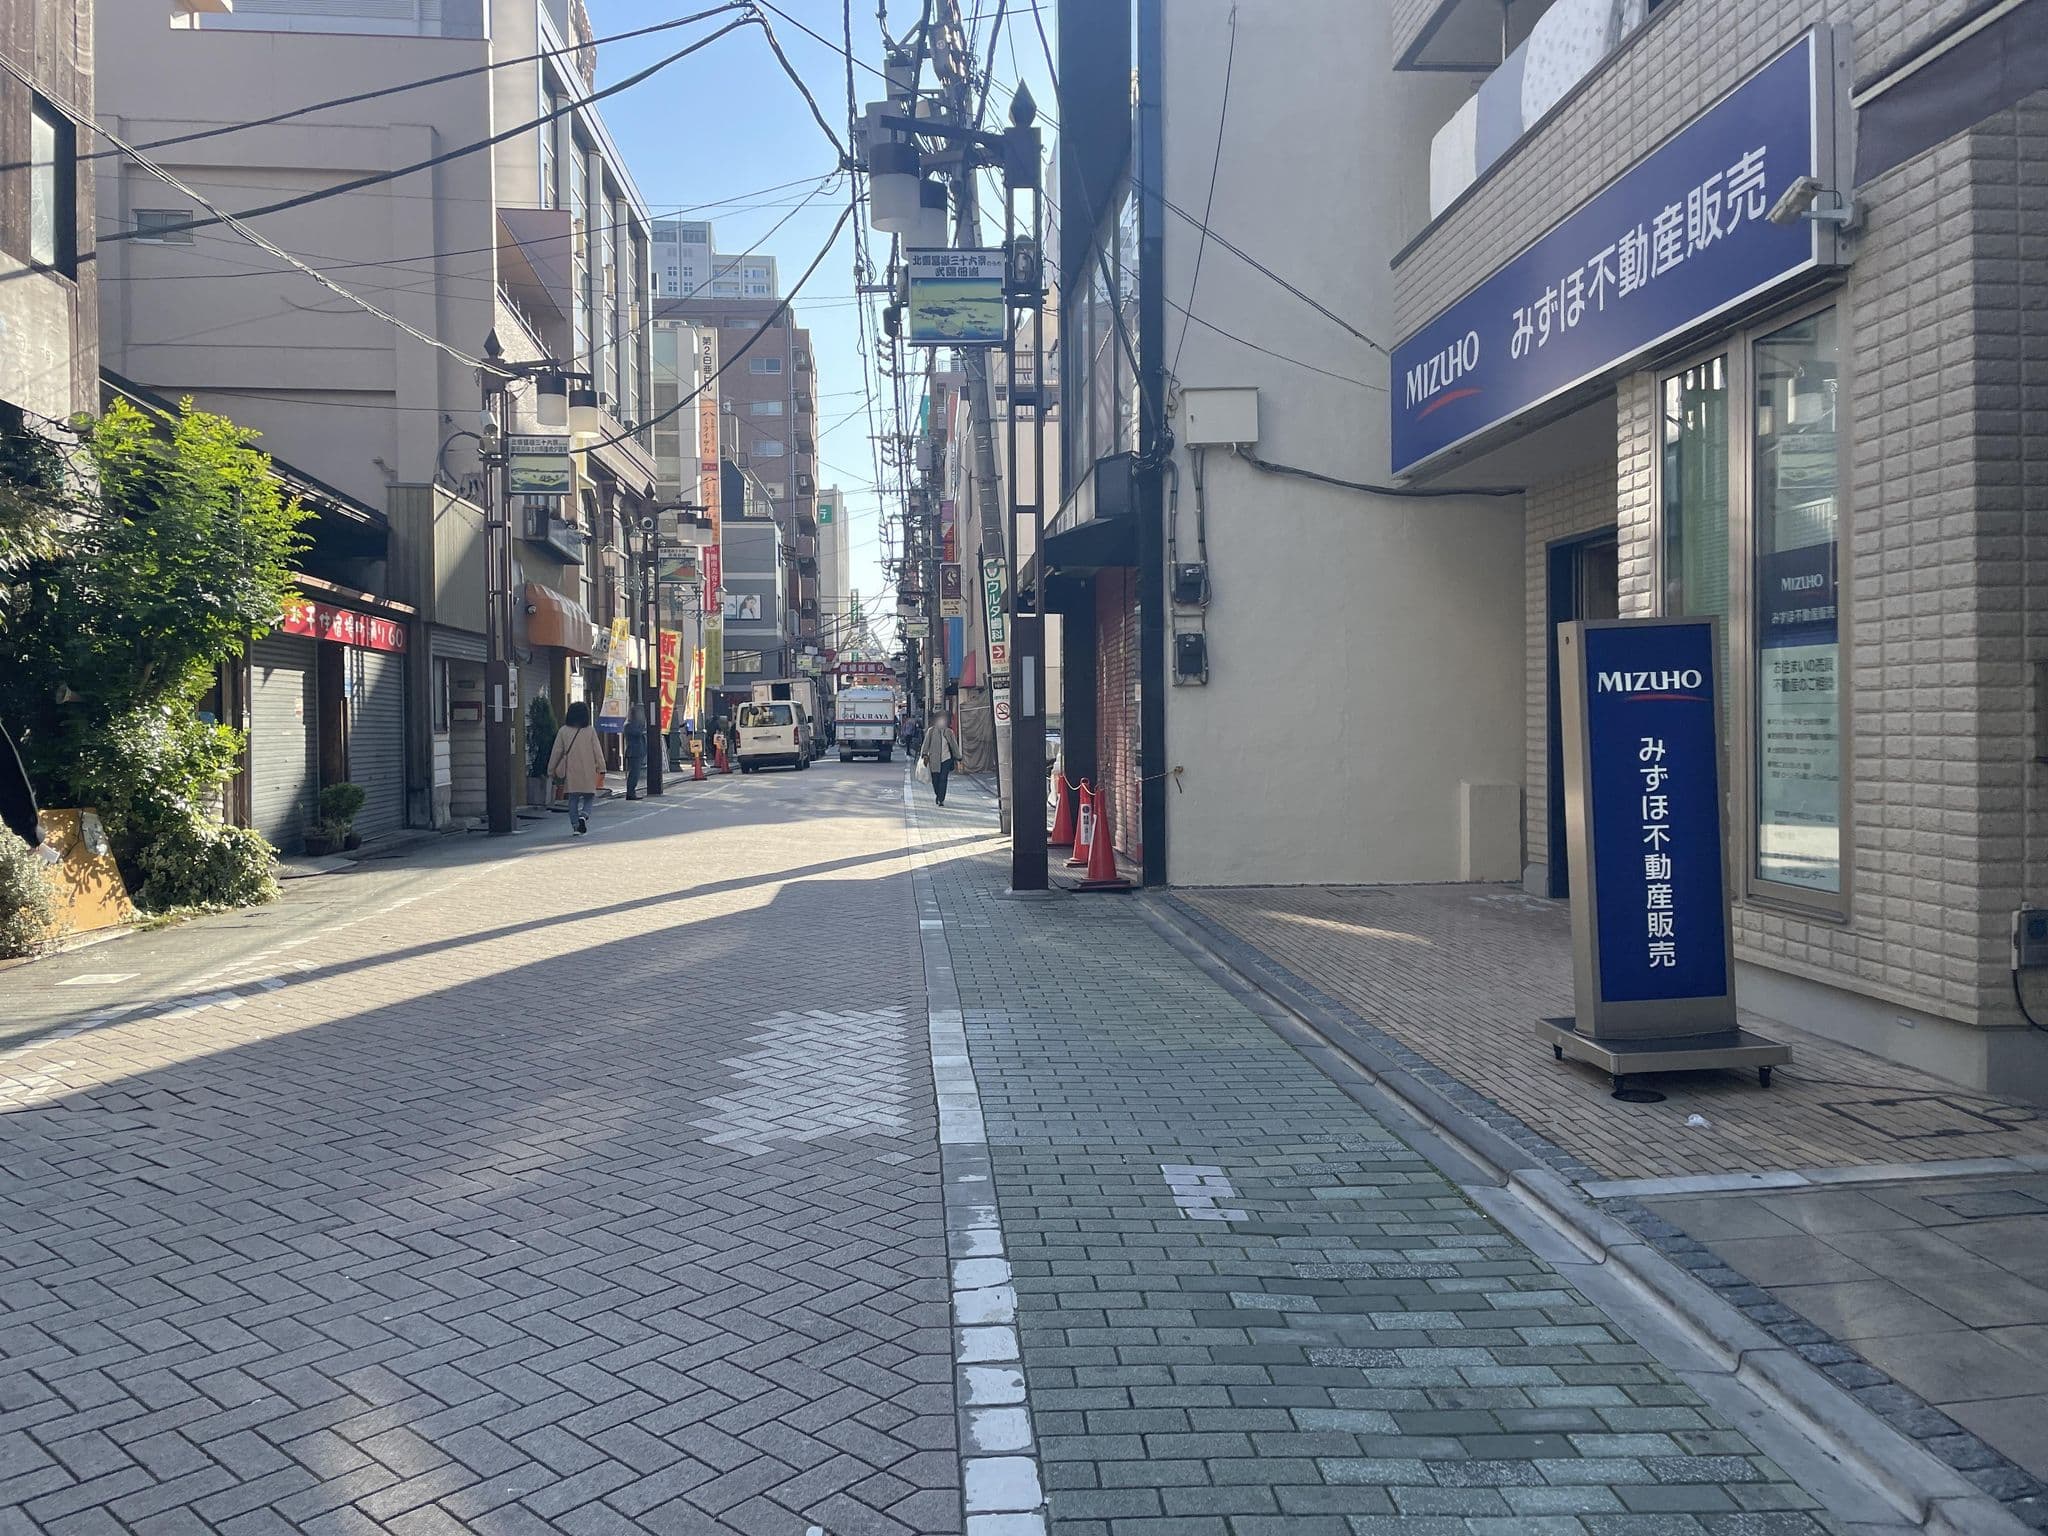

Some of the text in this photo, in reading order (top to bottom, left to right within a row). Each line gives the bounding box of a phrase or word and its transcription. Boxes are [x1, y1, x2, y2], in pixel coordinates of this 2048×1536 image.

[1510, 146, 1769, 359] みずほ不動産販売
[1406, 330, 1479, 409] MIZUHO
[1781, 574, 1823, 591] MIZUHO
[1771, 606, 1835, 624] みずほ不動産販売
[1598, 669, 1702, 693] MIZUHO
[1639, 737, 1676, 969] みずほ不動産販売
